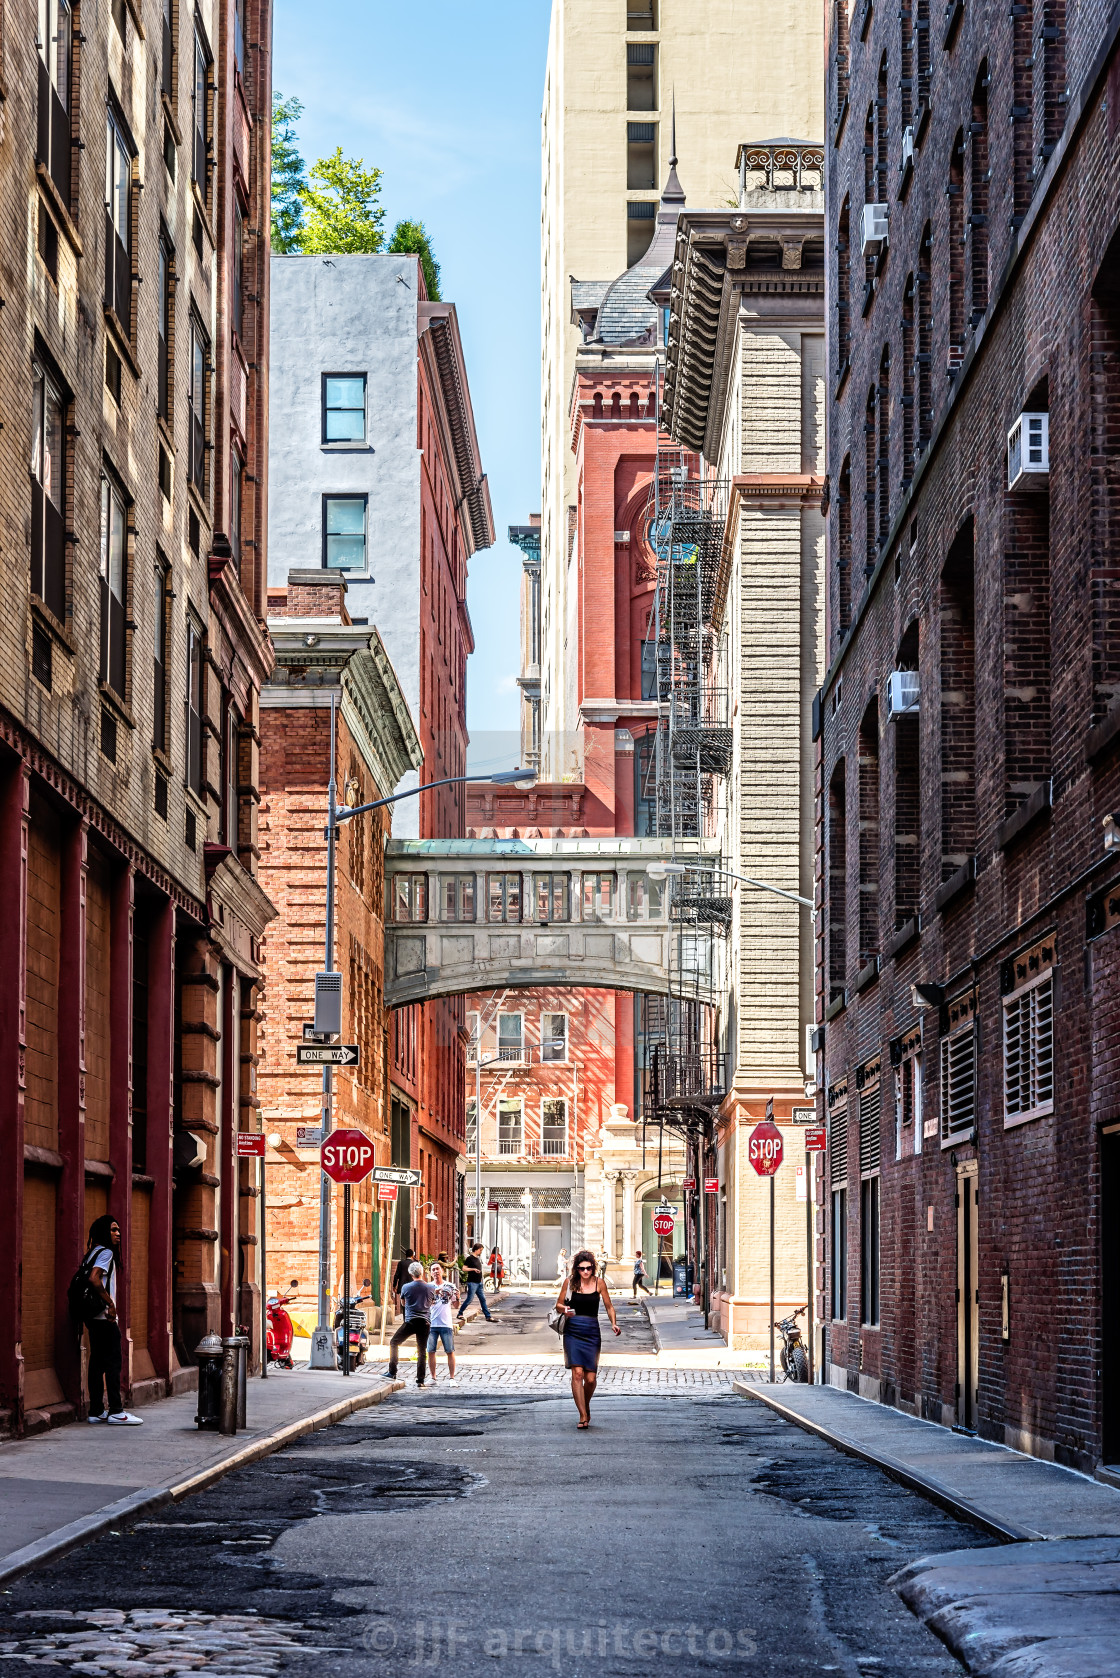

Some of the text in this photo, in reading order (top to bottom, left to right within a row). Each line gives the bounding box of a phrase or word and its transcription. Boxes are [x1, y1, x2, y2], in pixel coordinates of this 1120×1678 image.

[305, 1051, 349, 1059] ONE WAY
[750, 1138, 781, 1159] STOP
[323, 1146, 372, 1166] STOP
[379, 1171, 413, 1181] ONE WAY
[654, 1220, 674, 1229] STOP
